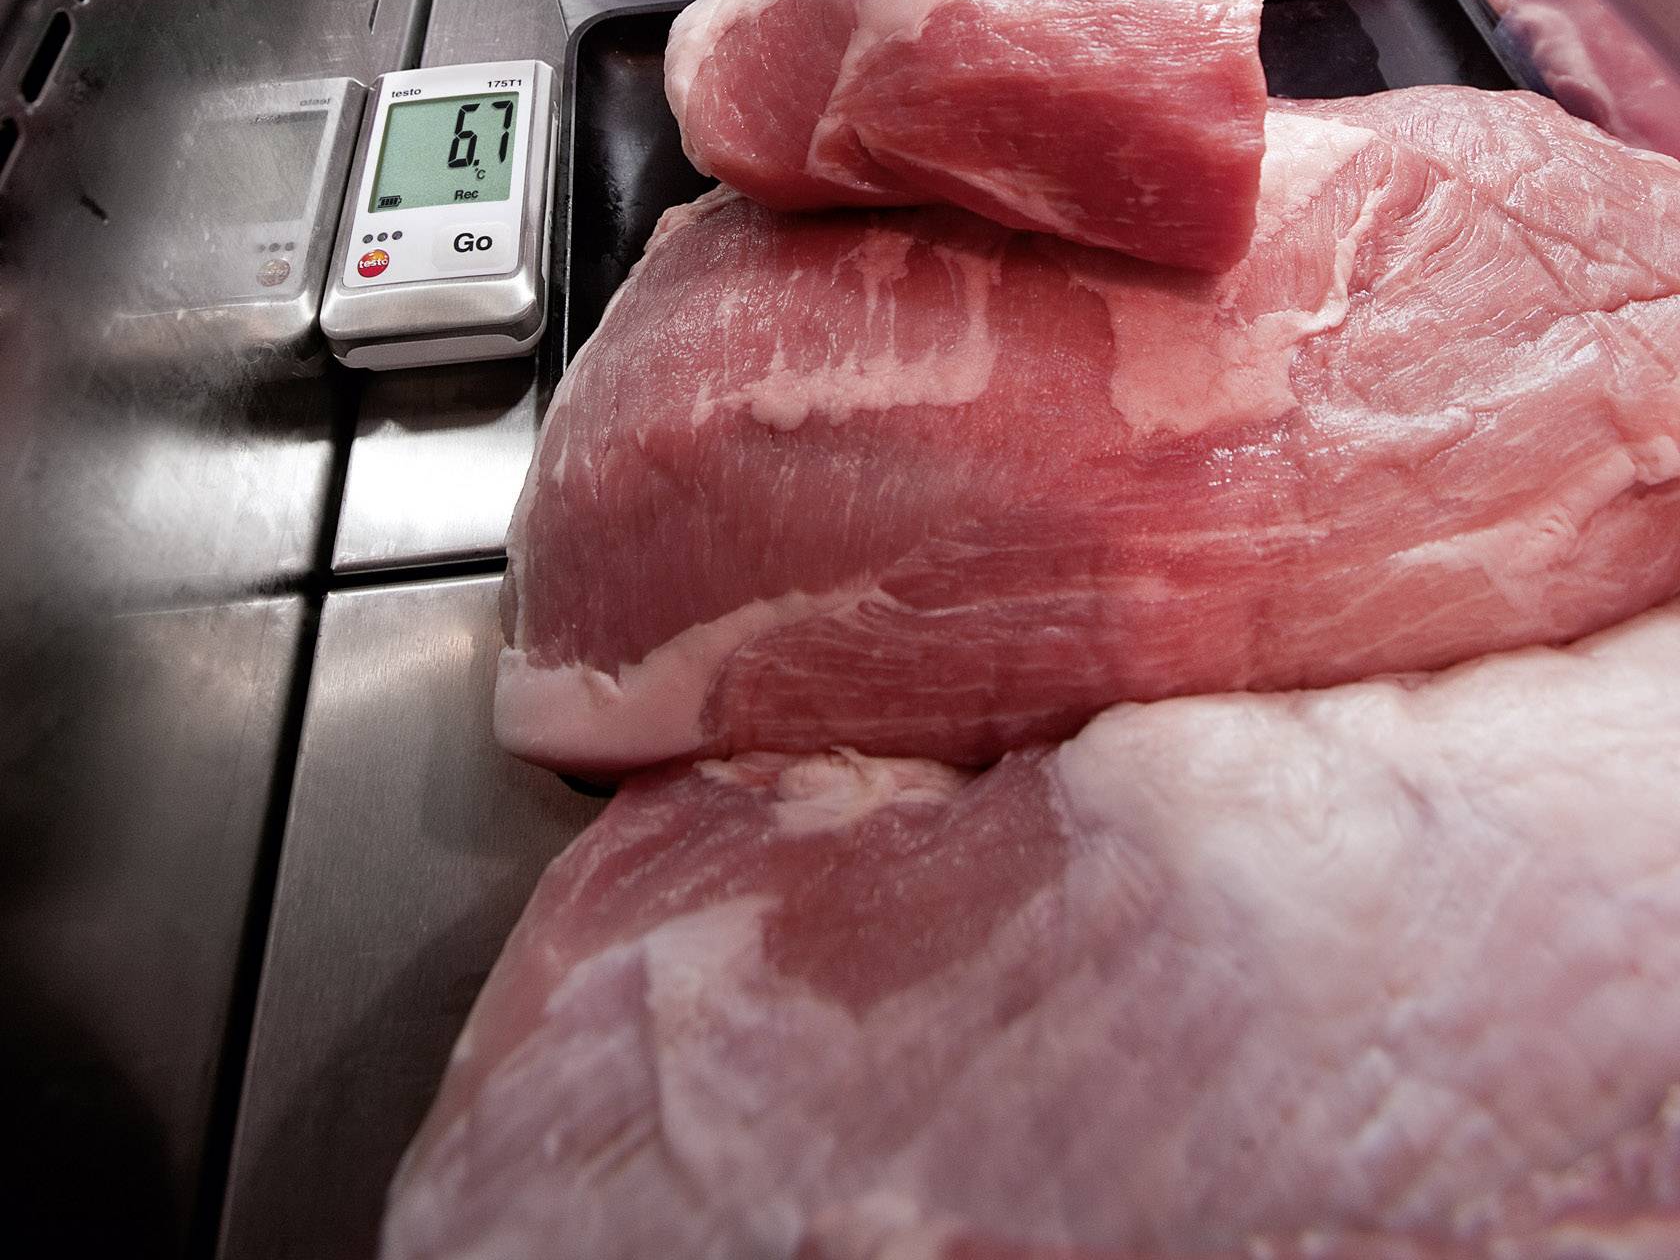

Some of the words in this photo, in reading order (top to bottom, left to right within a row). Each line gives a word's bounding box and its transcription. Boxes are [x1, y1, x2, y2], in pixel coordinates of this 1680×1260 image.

[487, 79, 522, 88] 175T1
[391, 88, 422, 98] testo
[454, 189, 479, 201] Rec
[453, 232, 493, 253] Go
[359, 258, 389, 269] testo
